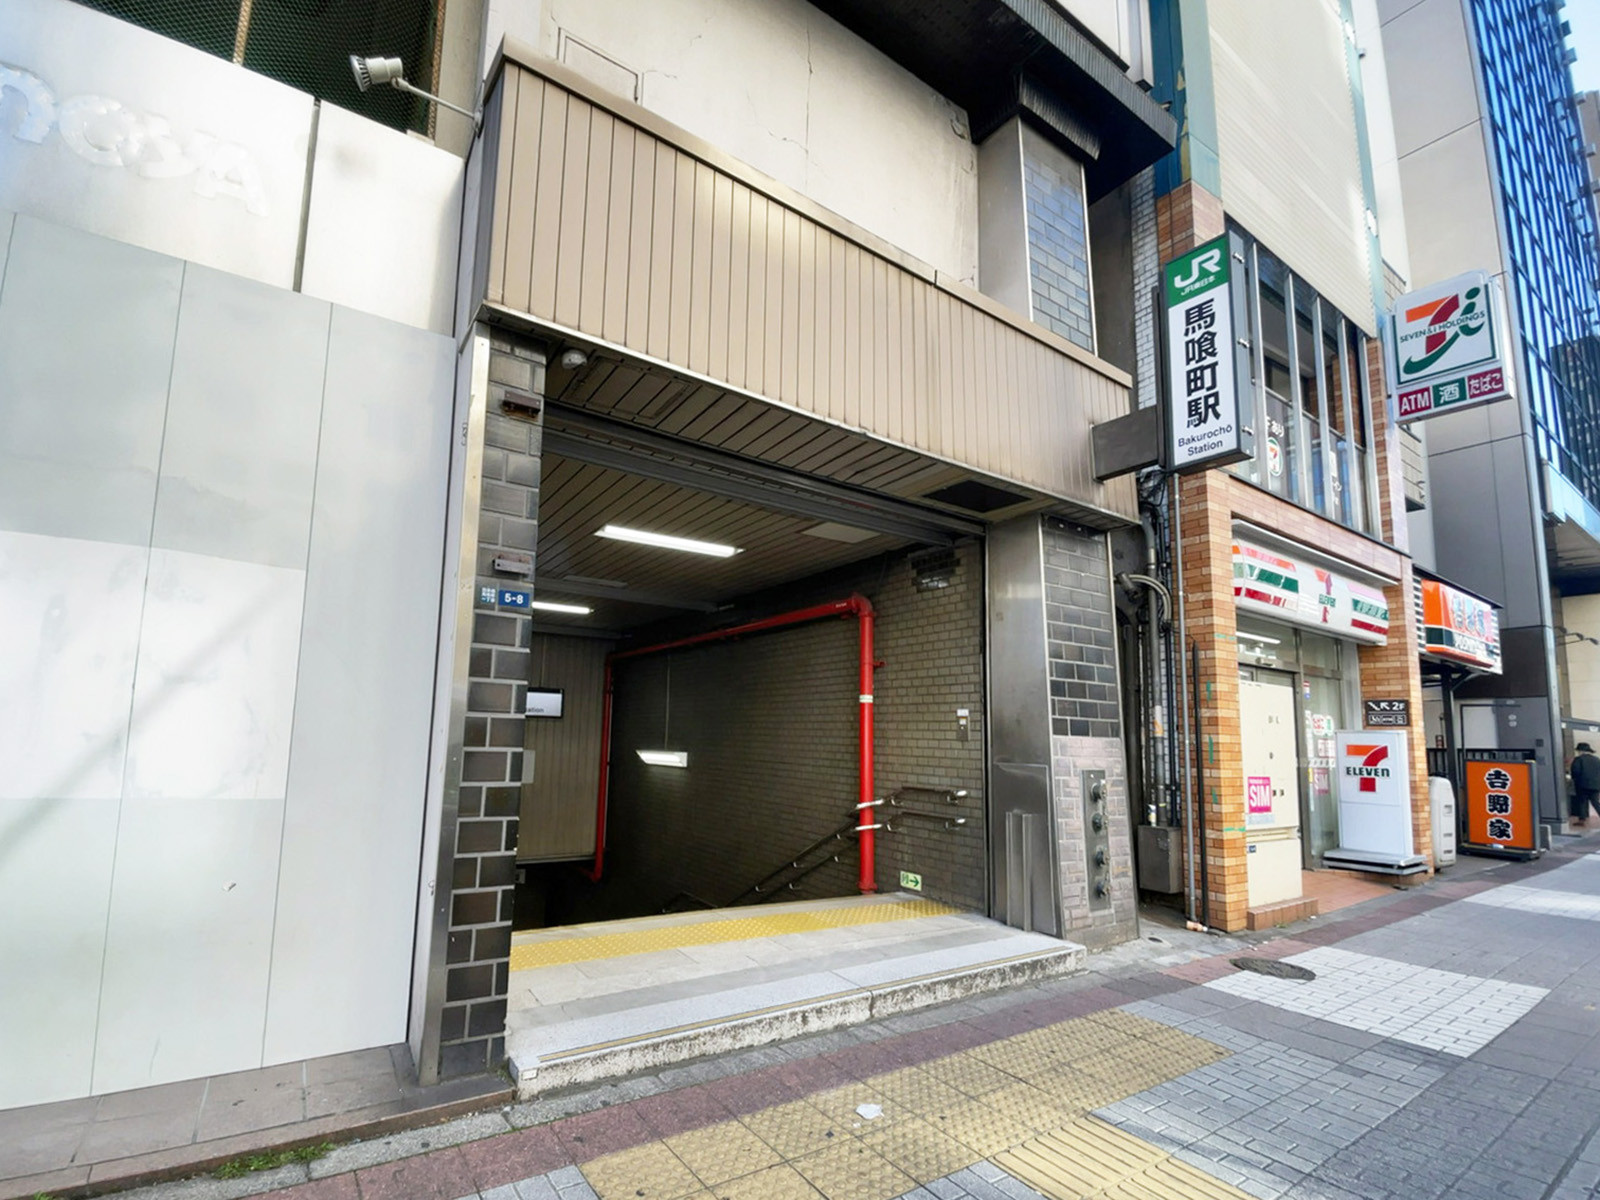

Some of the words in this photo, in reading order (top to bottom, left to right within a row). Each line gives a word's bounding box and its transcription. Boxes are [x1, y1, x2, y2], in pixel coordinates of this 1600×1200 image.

[1174, 248, 1221, 288] JR
[1438, 310, 1486, 332] HOLDINGS
[1184, 298, 1221, 429] 馬喰町駅
[1439, 383, 1460, 403] 酒
[1469, 374, 1502, 395] たばこ
[1401, 391, 1429, 413] ATM
[1187, 440, 1223, 456] Station
[504, 592, 524, 605] 5-8
[1392, 701, 1405, 711] 2F
[1249, 784, 1271, 808] SIM
[1485, 768, 1511, 840] 吉野家
